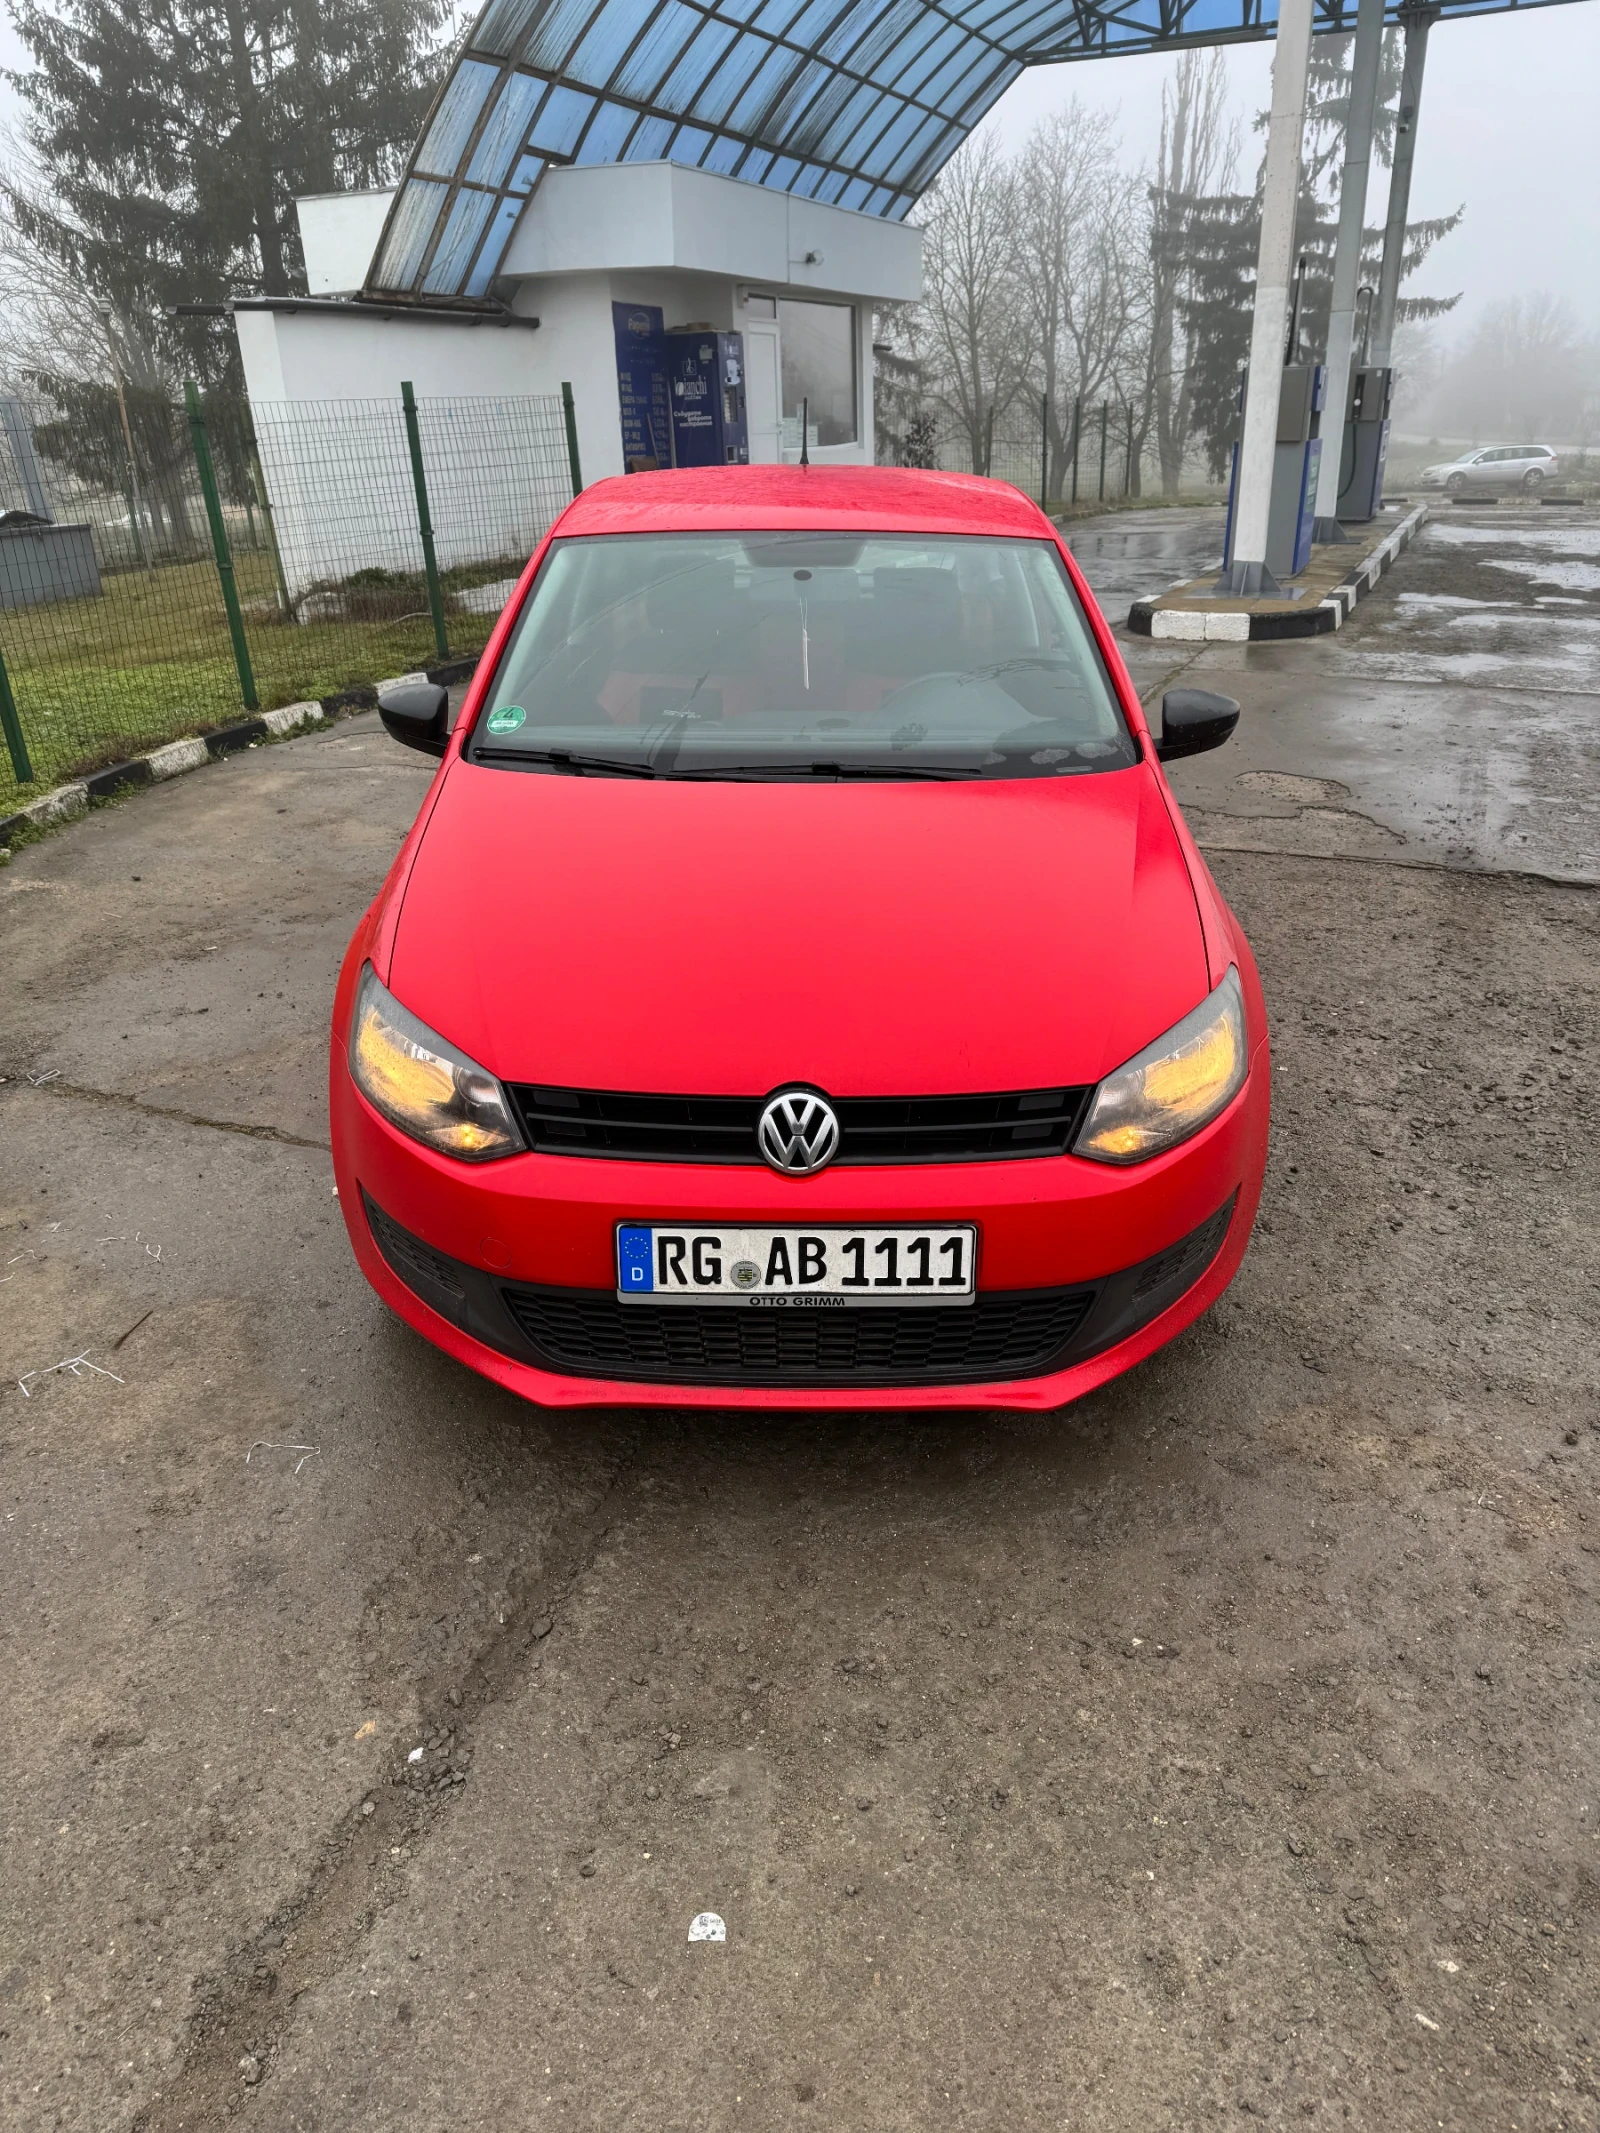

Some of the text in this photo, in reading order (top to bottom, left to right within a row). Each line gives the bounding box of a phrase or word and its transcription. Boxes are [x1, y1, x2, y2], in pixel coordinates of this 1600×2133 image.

[674, 375, 708, 396] bianchi
[503, 707, 514, 720] 4
[657, 1236, 722, 1286] RG
[764, 1236, 828, 1286] AB
[841, 1236, 966, 1287] 1111
[631, 1267, 644, 1281] D
[749, 1296, 846, 1306] OTTO GRIMM
